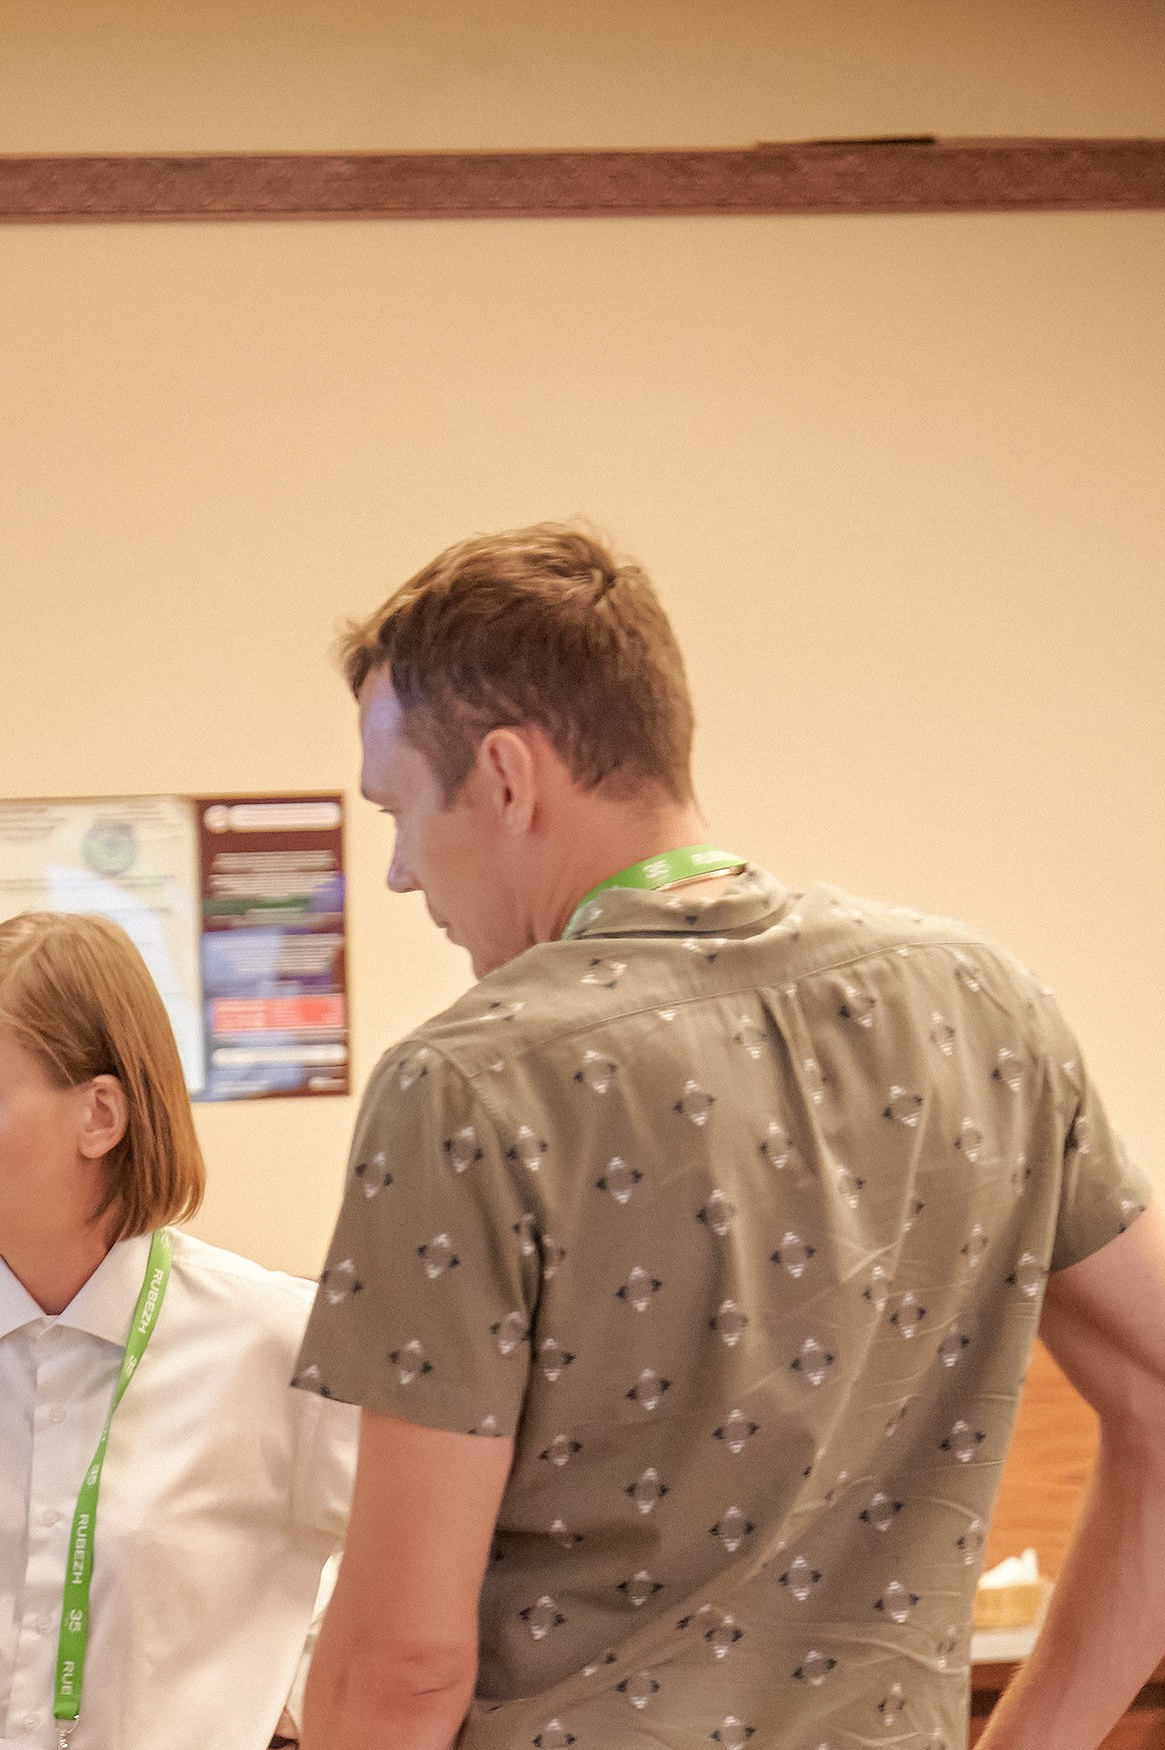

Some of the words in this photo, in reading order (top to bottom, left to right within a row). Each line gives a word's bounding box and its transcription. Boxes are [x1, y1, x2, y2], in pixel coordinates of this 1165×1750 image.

[138, 1268, 164, 1334] RUBEZH
[71, 1513, 90, 1584] RUBEZH
[68, 1609, 83, 1632] 35
